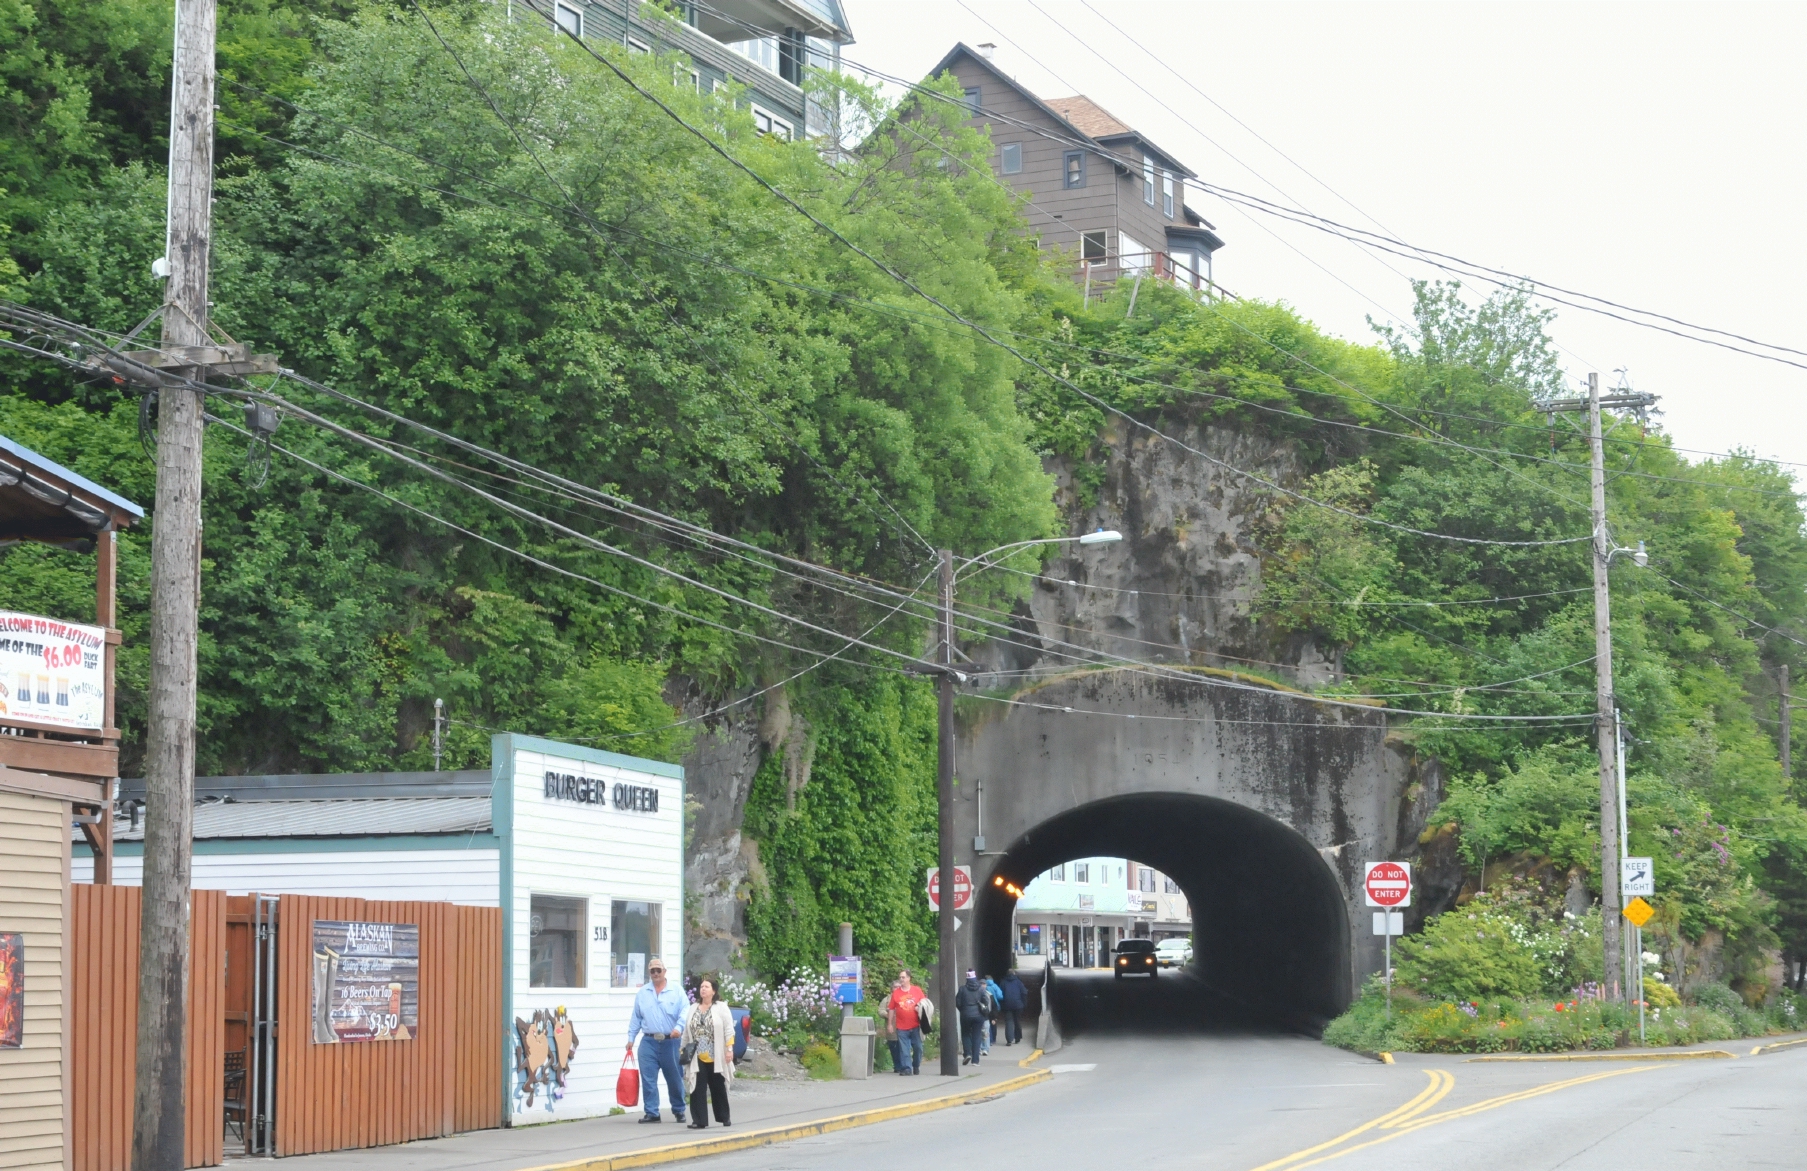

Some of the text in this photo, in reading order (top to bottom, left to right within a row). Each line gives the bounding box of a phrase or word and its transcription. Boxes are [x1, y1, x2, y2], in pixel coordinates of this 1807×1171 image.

[0, 618, 103, 650] ELCOME TO THE ASYLUM
[0, 638, 82, 670] ME OF THE $6.00
[83, 652, 99, 662] DUCK
[545, 771, 659, 812] BURGER QUEEN
[955, 874, 964, 882] OT
[1375, 890, 1400, 898] ENTER
[343, 924, 393, 955] ALASKAN
[593, 927, 608, 942] 518
[356, 943, 378, 952] BREWING
[341, 985, 392, 1001] 16 Beers On Tap
[369, 1012, 397, 1036] $3.50
